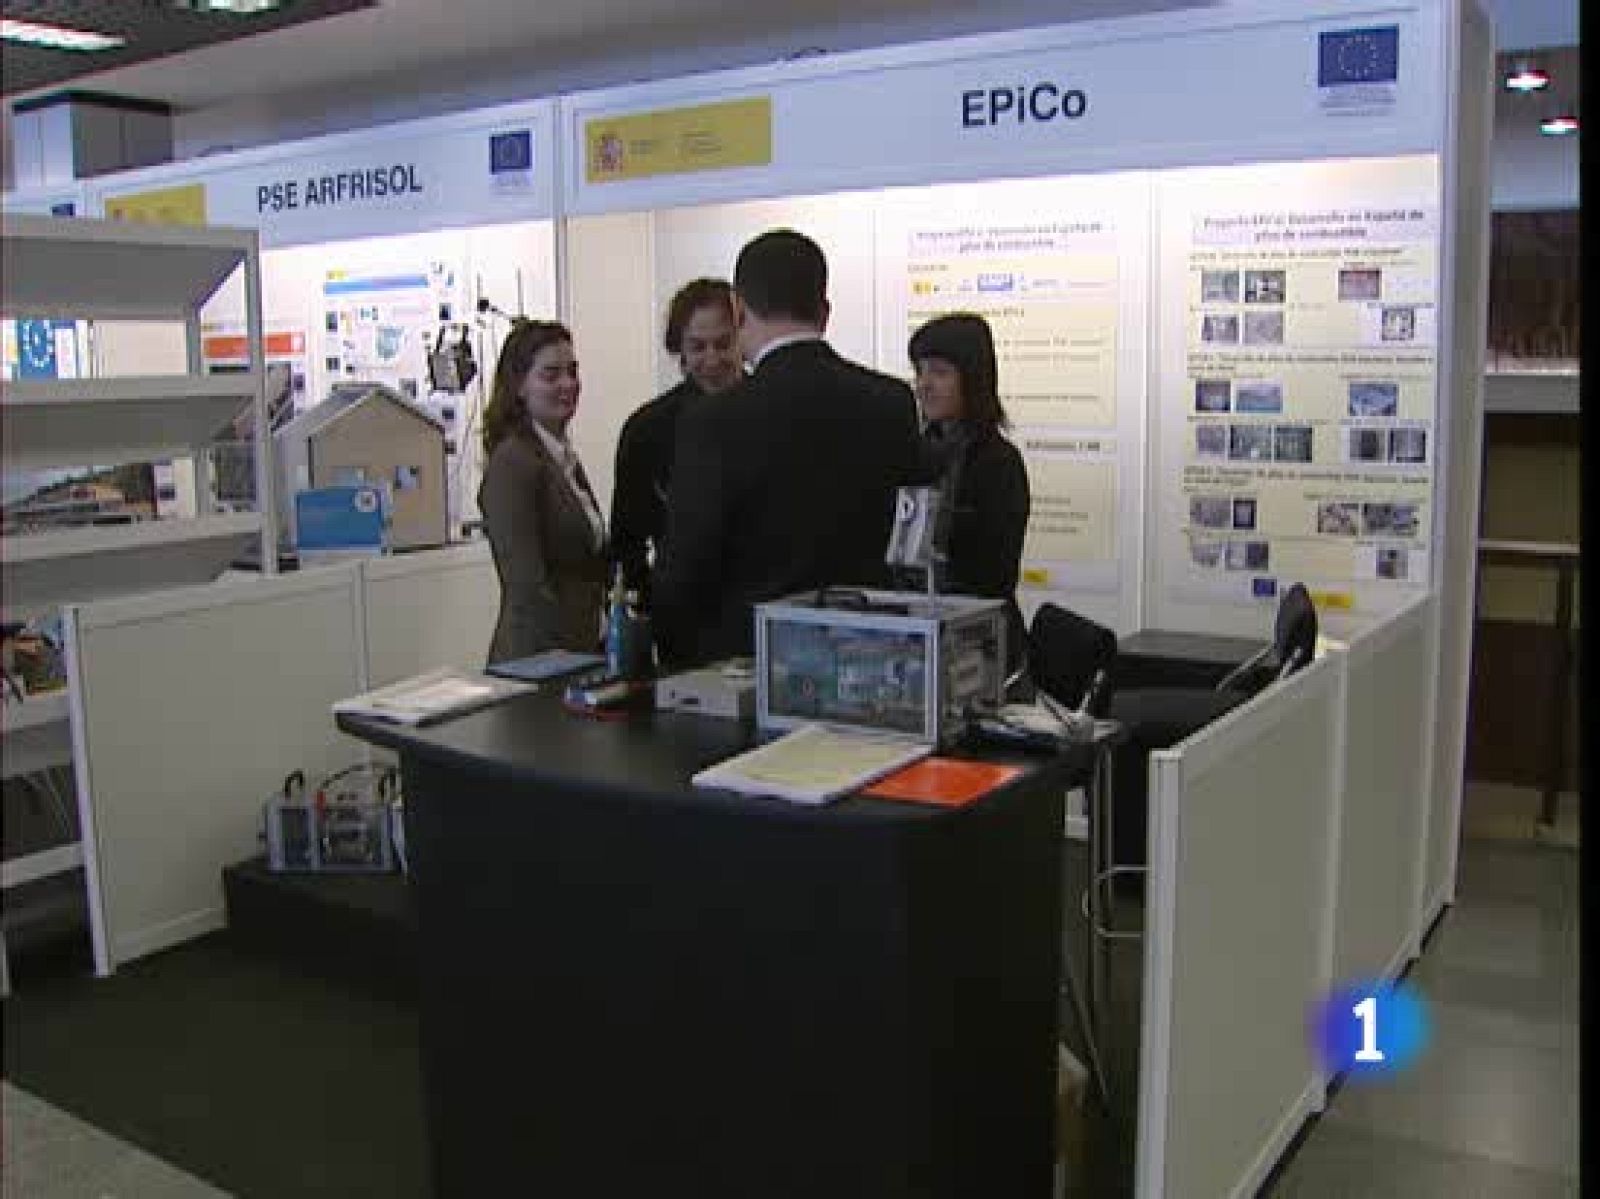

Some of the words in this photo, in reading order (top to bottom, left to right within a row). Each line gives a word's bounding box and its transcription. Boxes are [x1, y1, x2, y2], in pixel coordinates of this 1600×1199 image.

[962, 81, 1088, 128] EPiCo
[257, 181, 298, 213] PSE
[304, 163, 423, 206] ARFRISOL
